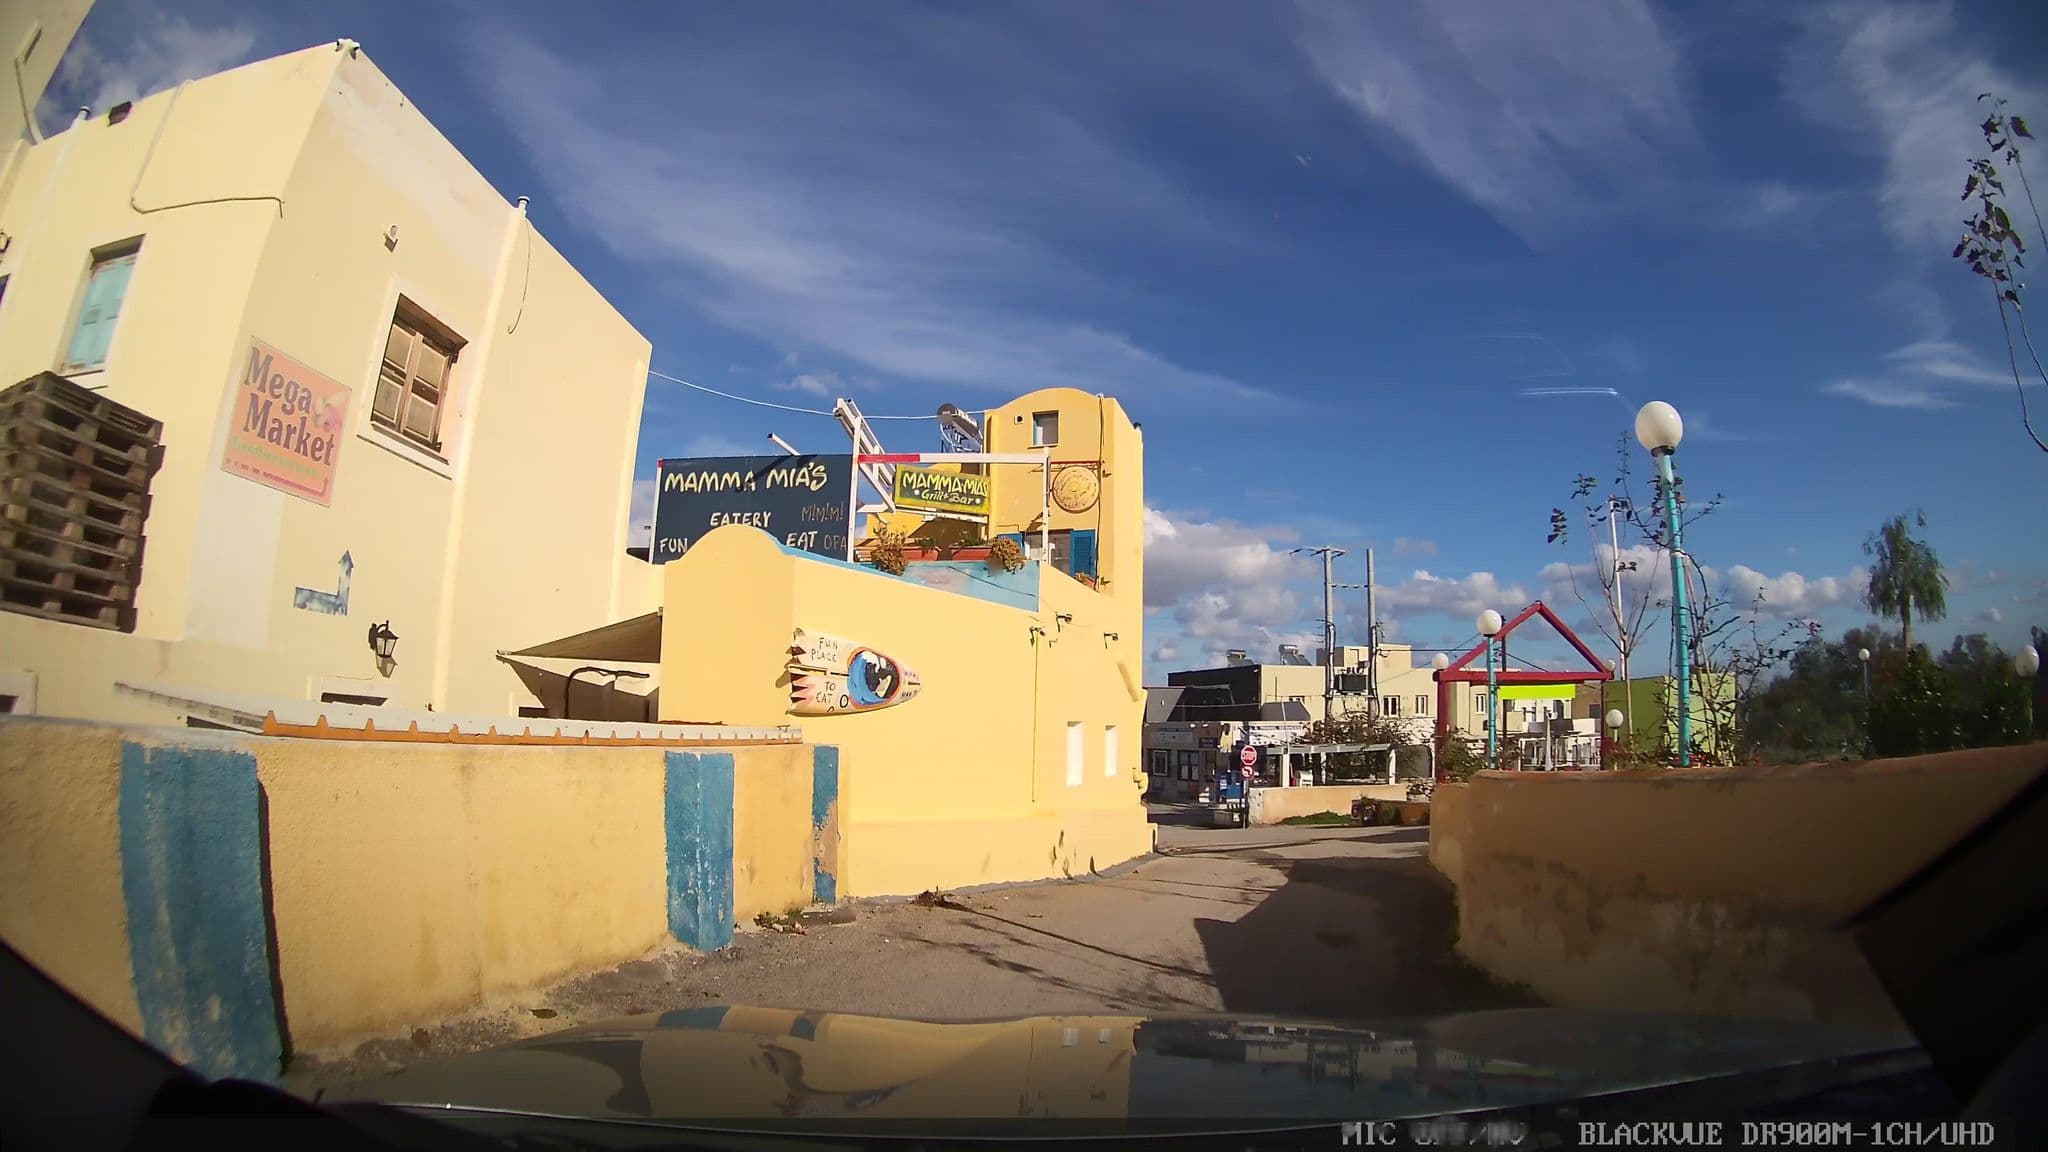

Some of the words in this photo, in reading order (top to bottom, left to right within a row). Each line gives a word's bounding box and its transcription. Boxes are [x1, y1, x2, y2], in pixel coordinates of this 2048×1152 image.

[243, 346, 312, 416] Mega
[242, 392, 335, 466] Market
[664, 471, 757, 494] MAMMA
[766, 462, 828, 492] MIA'S
[948, 492, 974, 505] Bar
[710, 511, 772, 528] EATERY
[659, 537, 688, 553] FUN
[786, 531, 818, 551] EAT
[819, 637, 838, 650] FUN
[811, 648, 837, 662] PLACE
[825, 681, 836, 691] TO
[816, 692, 833, 703] EAT
